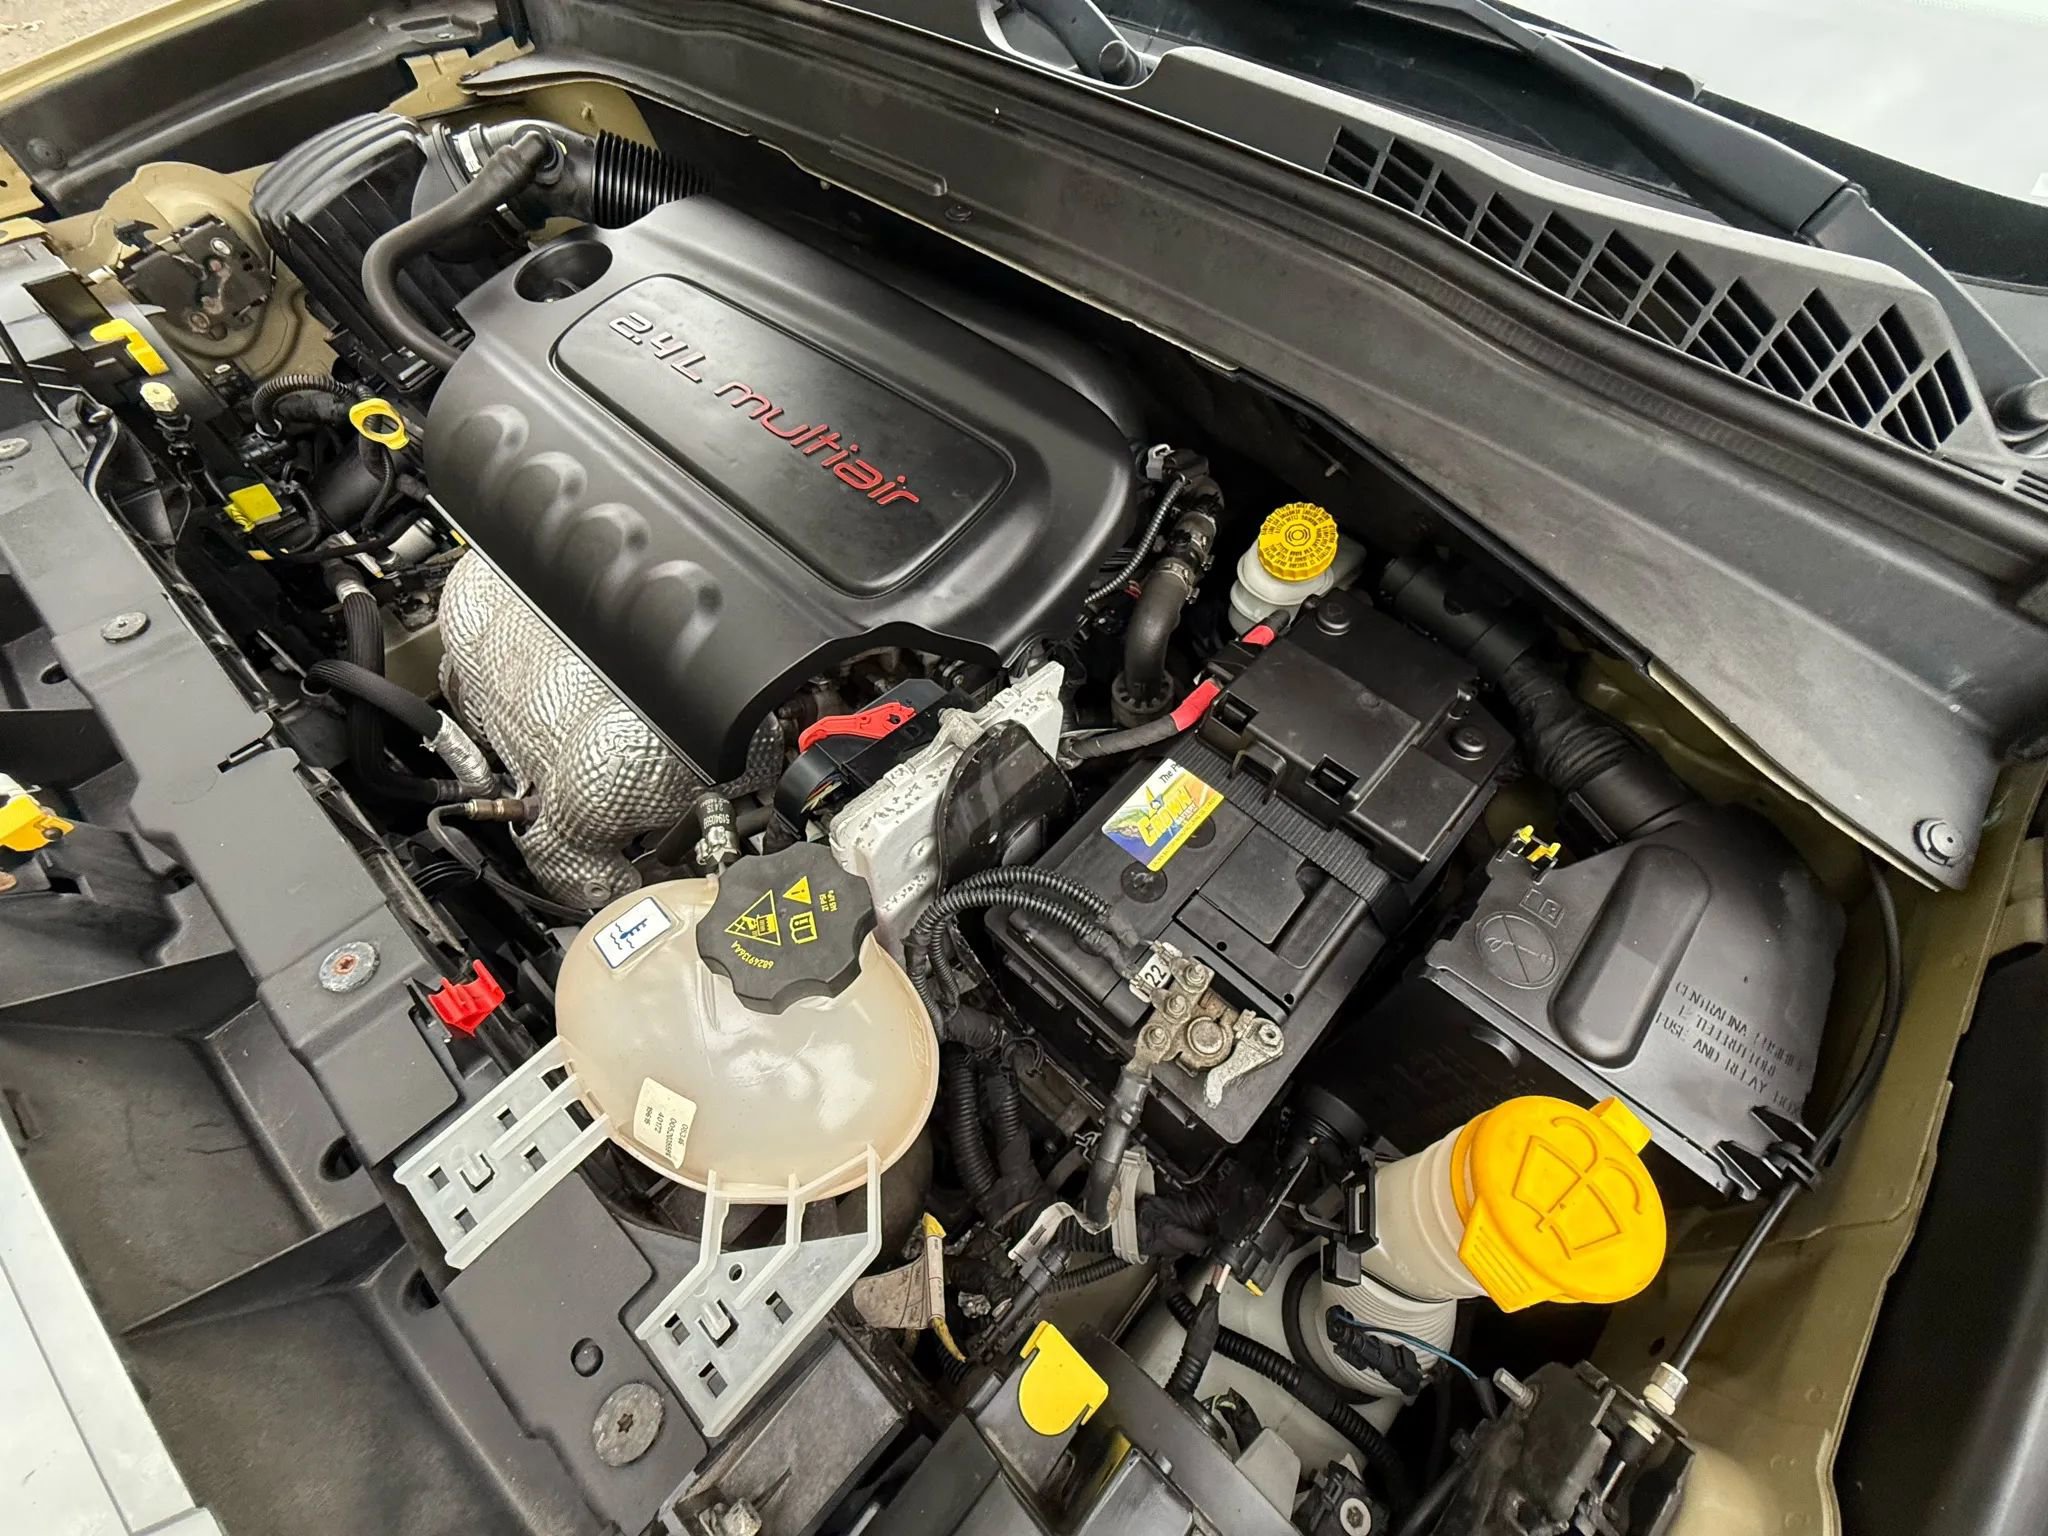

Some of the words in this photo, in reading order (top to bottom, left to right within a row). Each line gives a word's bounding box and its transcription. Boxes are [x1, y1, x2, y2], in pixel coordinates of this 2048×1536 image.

[608, 311, 707, 384] 2.4L
[713, 380, 920, 507] multiair
[1158, 771, 1173, 784] The
[1145, 964, 1167, 988] 22
[1692, 1039, 1720, 1063] AND
